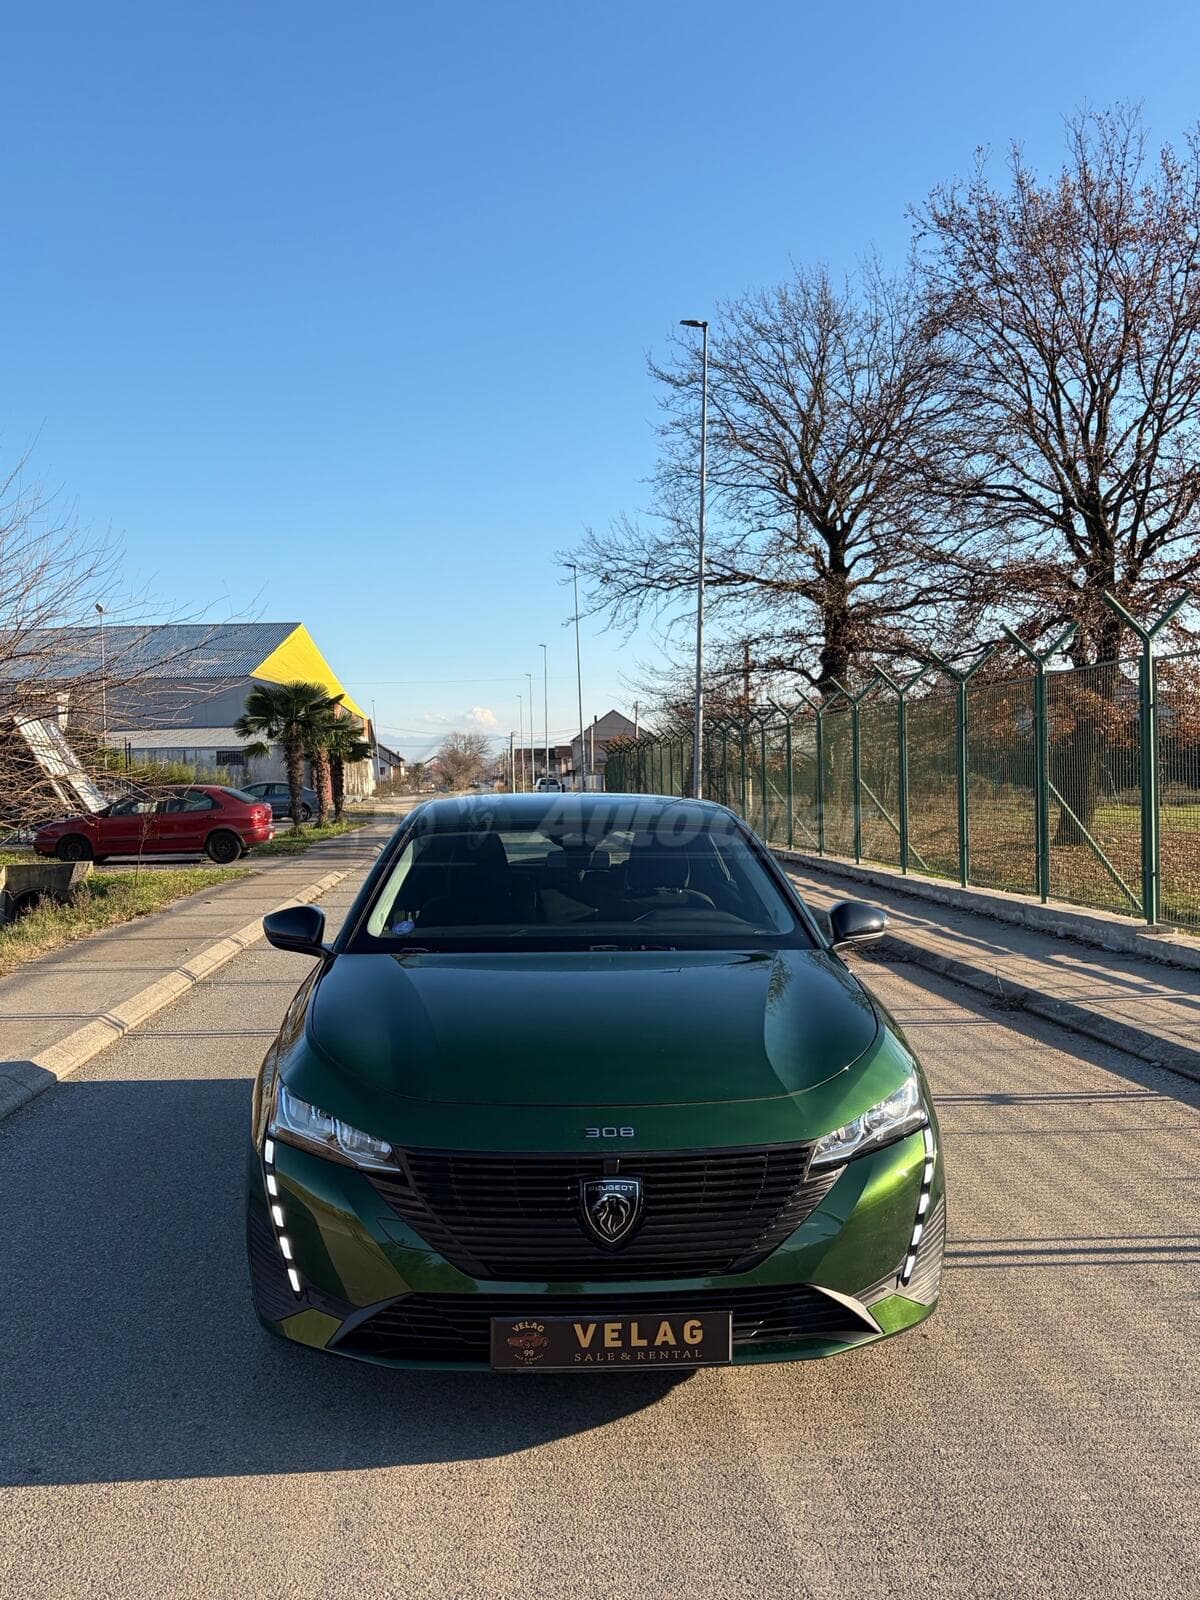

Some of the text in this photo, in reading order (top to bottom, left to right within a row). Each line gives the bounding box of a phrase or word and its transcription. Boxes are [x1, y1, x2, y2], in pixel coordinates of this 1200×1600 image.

[585, 1126, 635, 1138] 308
[512, 1321, 545, 1332] VELAG
[573, 1319, 703, 1348] VELAG
[523, 1349, 535, 1357] 99
[574, 1349, 702, 1362] SALE & RENTAL
